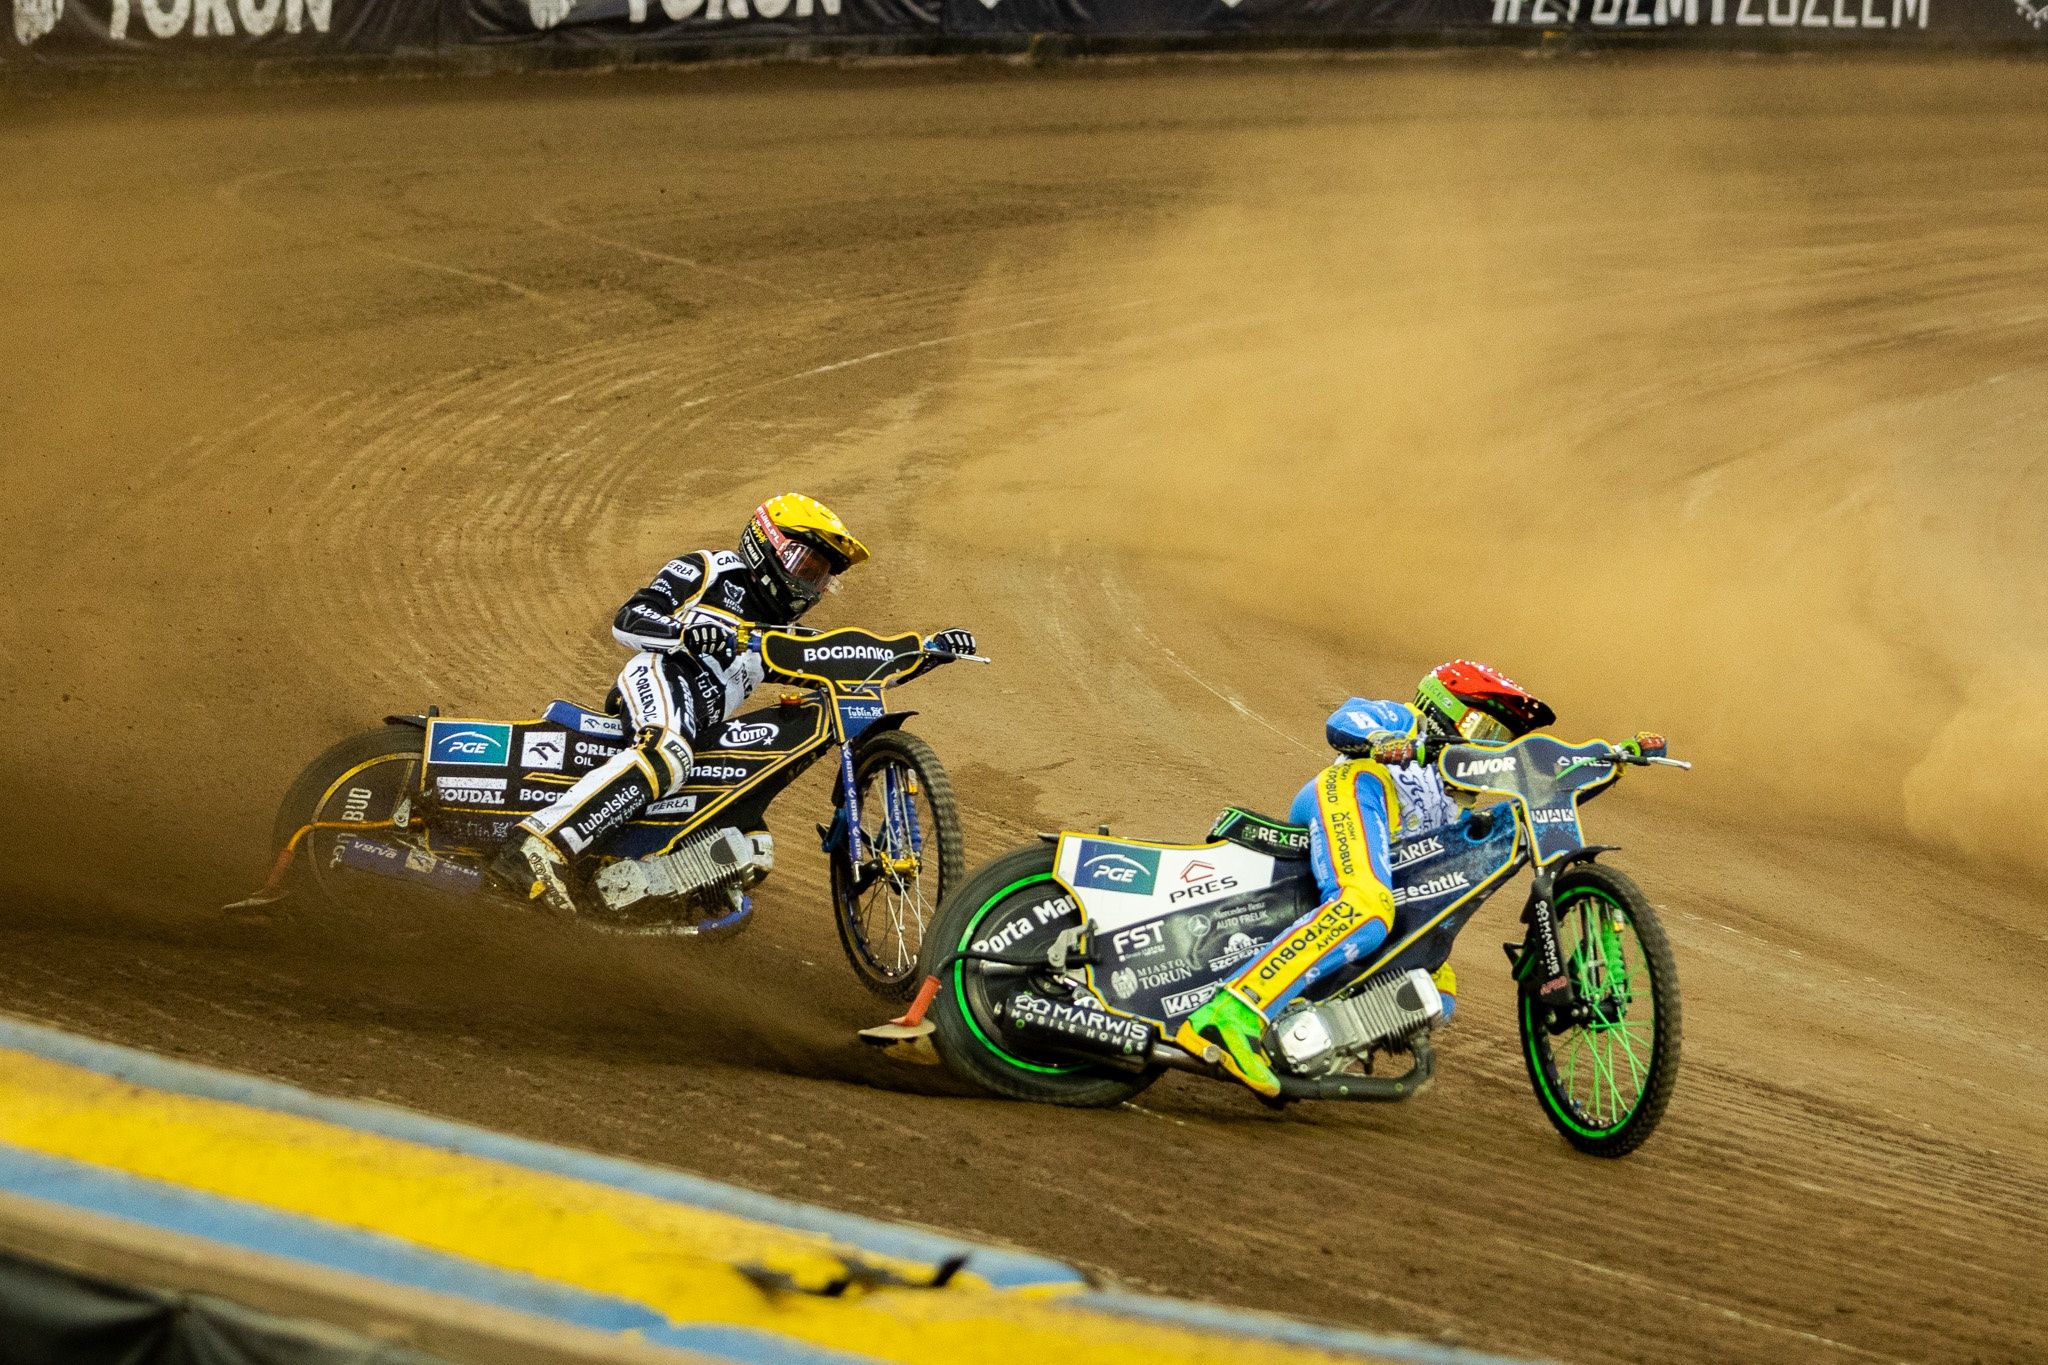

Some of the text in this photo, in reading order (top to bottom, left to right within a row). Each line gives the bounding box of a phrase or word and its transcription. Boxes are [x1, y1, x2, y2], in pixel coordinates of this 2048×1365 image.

[448, 741, 489, 754] PGE
[731, 727, 768, 743] LOTTO
[573, 755, 594, 767] OIL
[1456, 756, 1516, 777] LAVOR
[341, 787, 373, 821] BUD
[1257, 826, 1310, 849] REXER
[1093, 864, 1137, 883] PGE
[1169, 876, 1238, 904] PRES
[971, 916, 1035, 954] Porta
[1112, 919, 1165, 955] FST
[1259, 913, 1338, 980] EXPOBUD
[1316, 922, 1349, 951] DOMY
[1136, 958, 1184, 978] MIASTO
[1010, 1008, 1077, 1034] MOBILE
[1052, 1002, 1149, 1041] MARWIS
